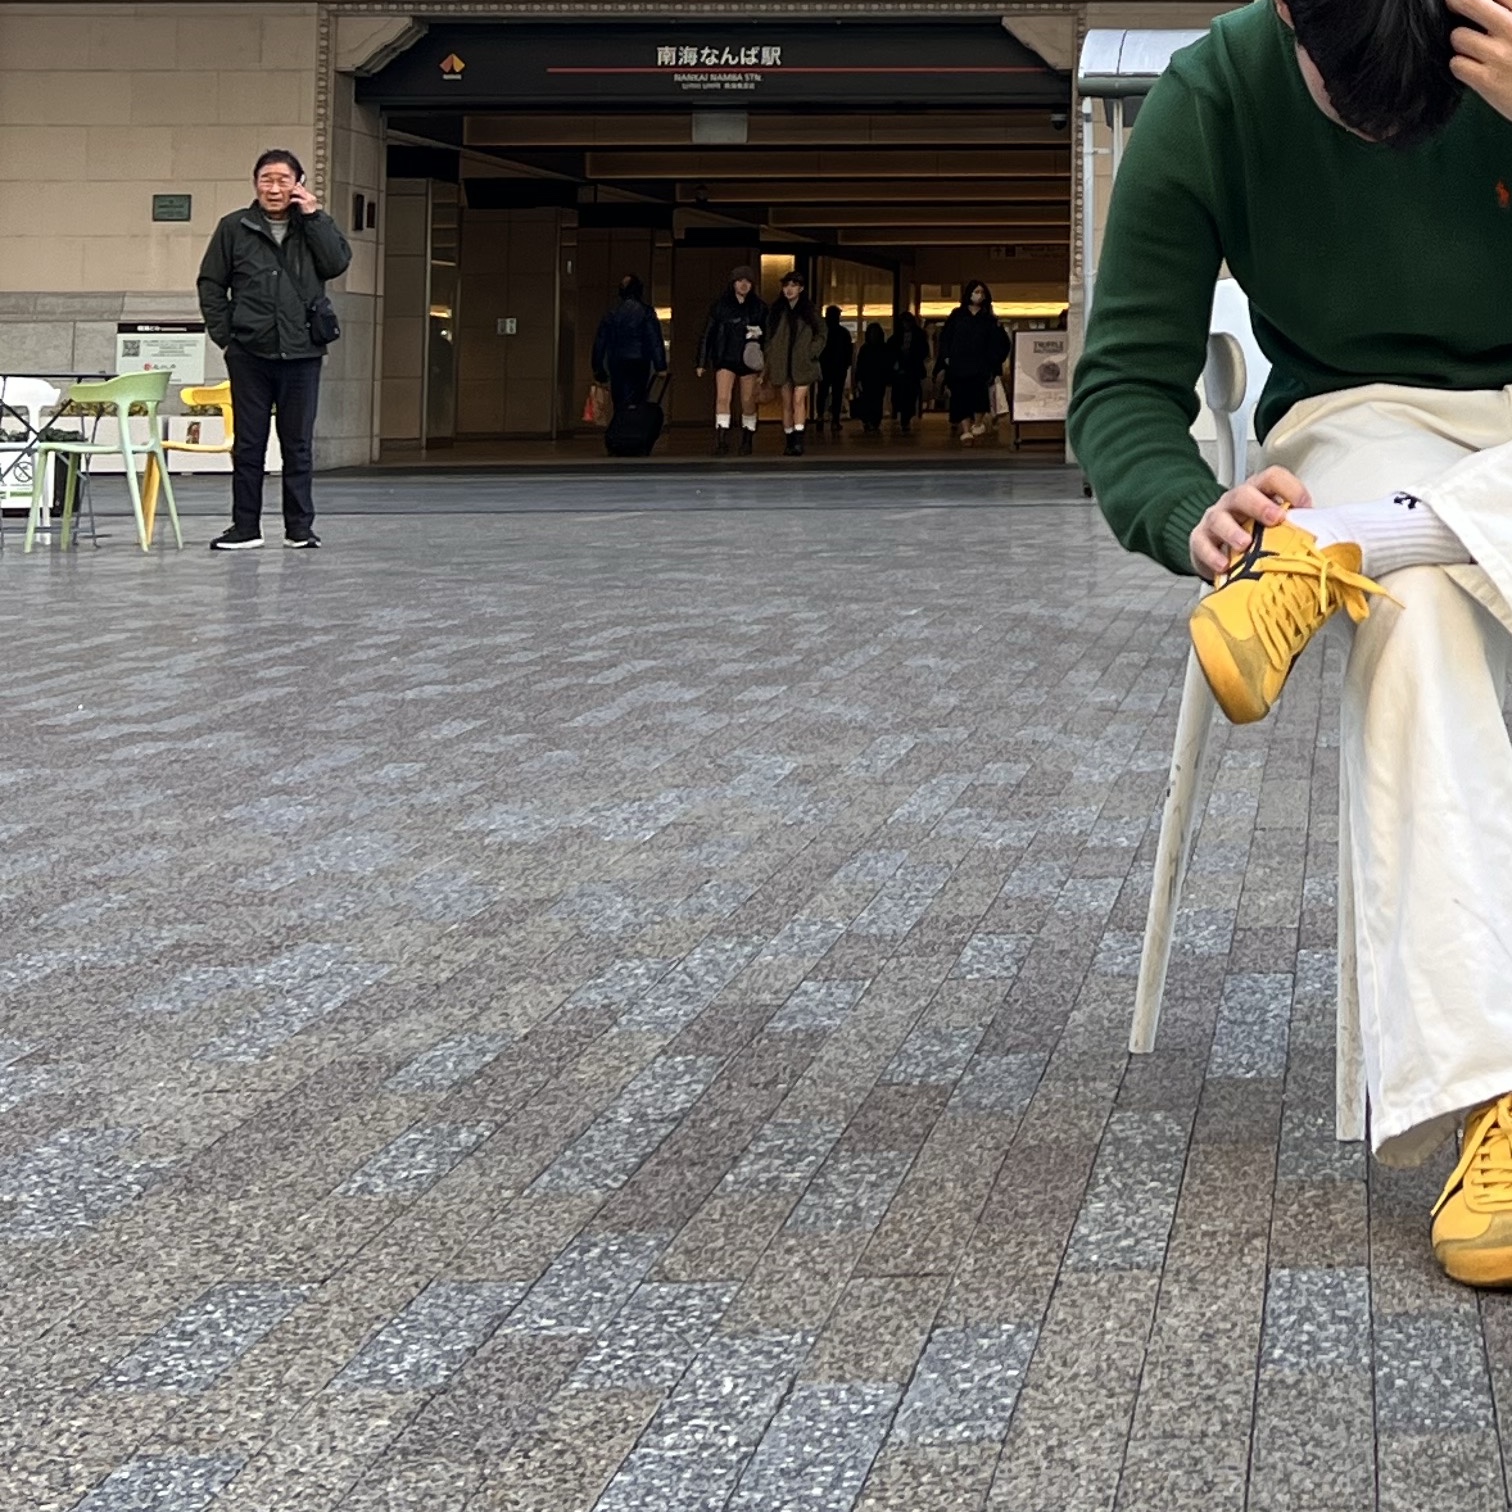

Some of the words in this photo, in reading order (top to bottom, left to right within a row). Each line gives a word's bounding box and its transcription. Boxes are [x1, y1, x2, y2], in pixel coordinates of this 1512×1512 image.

[657, 46, 782, 66] 南海なんば駅
